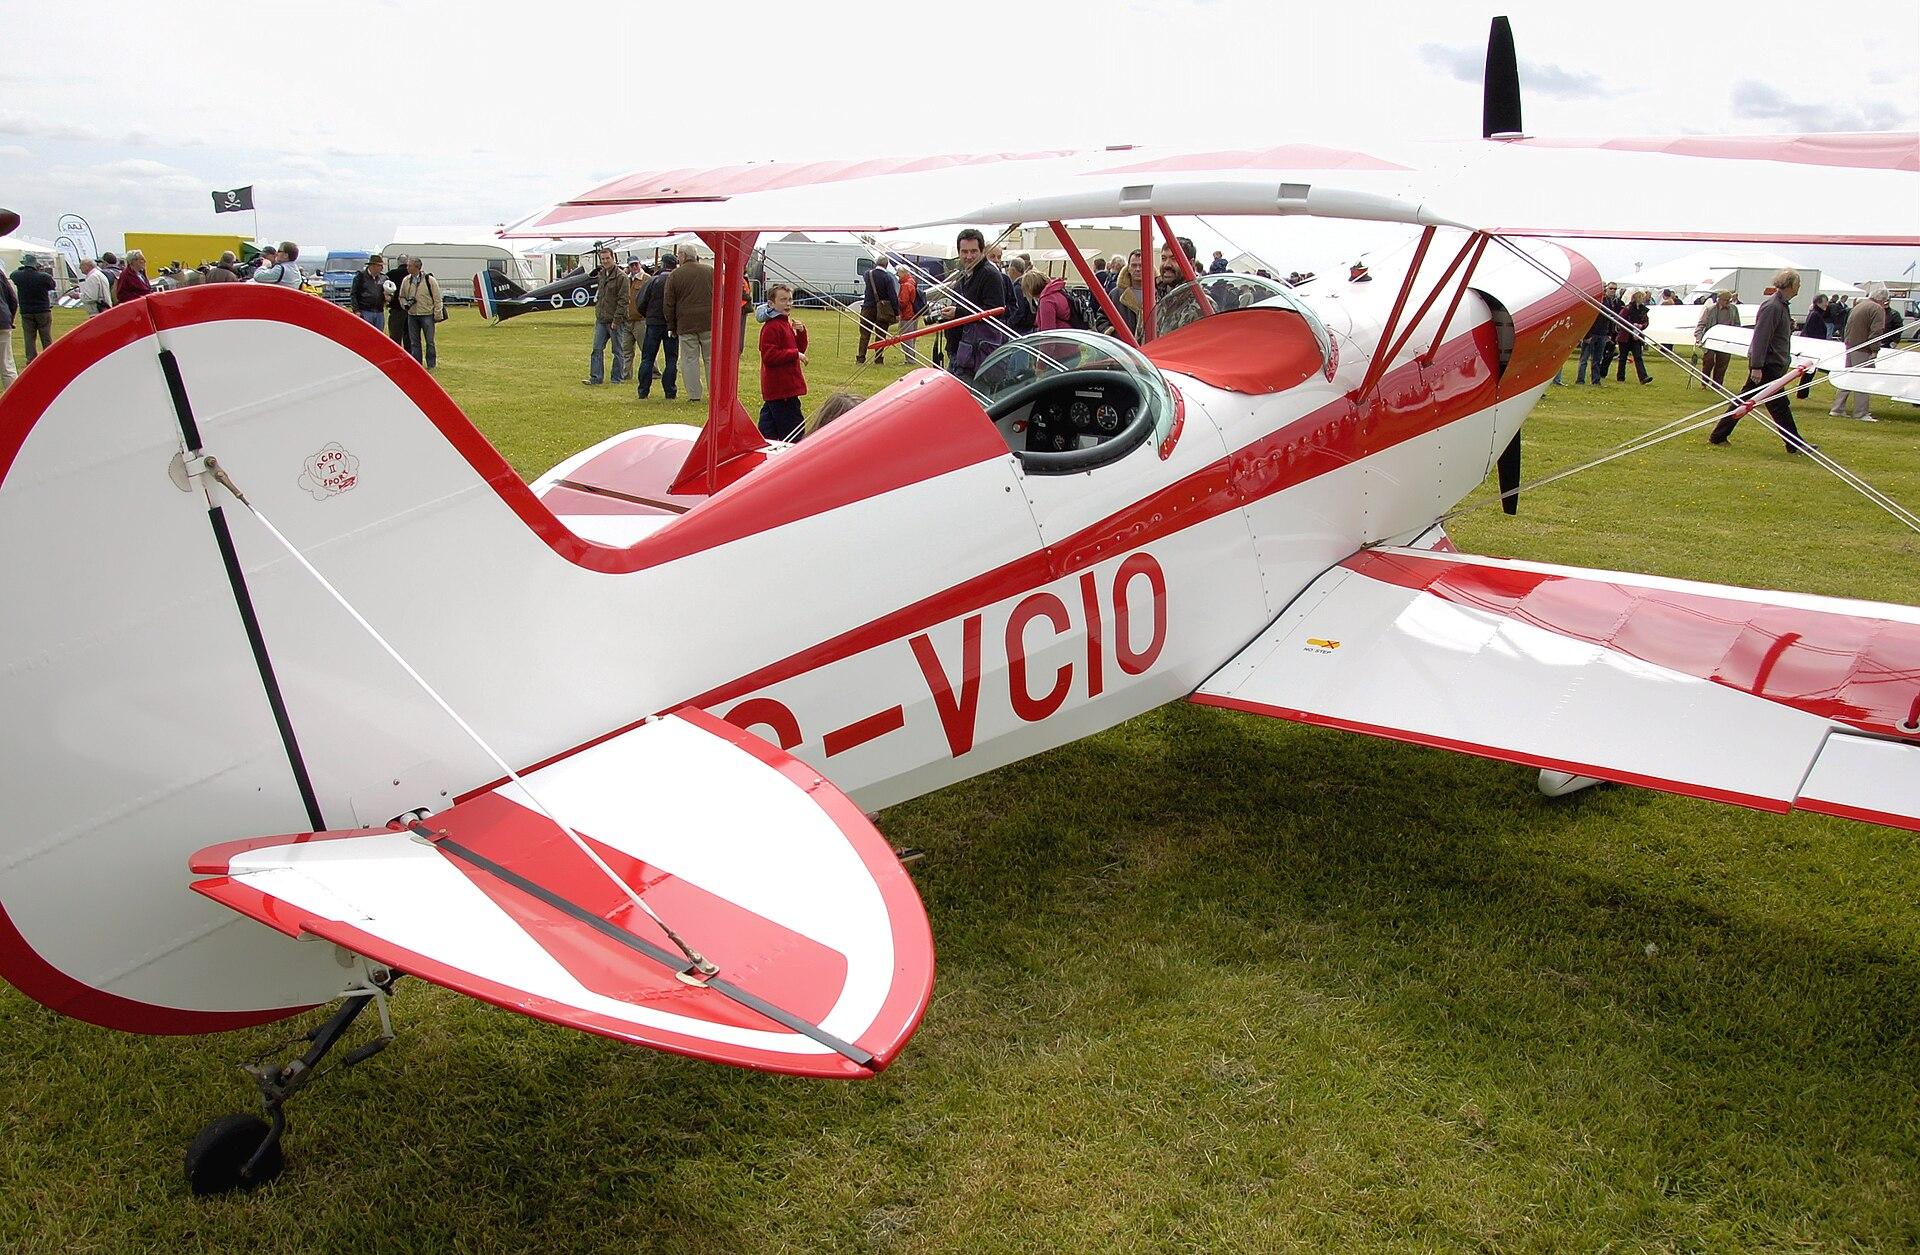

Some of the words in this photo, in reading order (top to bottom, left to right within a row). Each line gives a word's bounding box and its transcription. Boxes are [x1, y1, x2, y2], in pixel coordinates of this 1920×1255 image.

[317, 452, 342, 469] ACRO
[328, 464, 336, 474] II
[323, 469, 348, 487] SPORT
